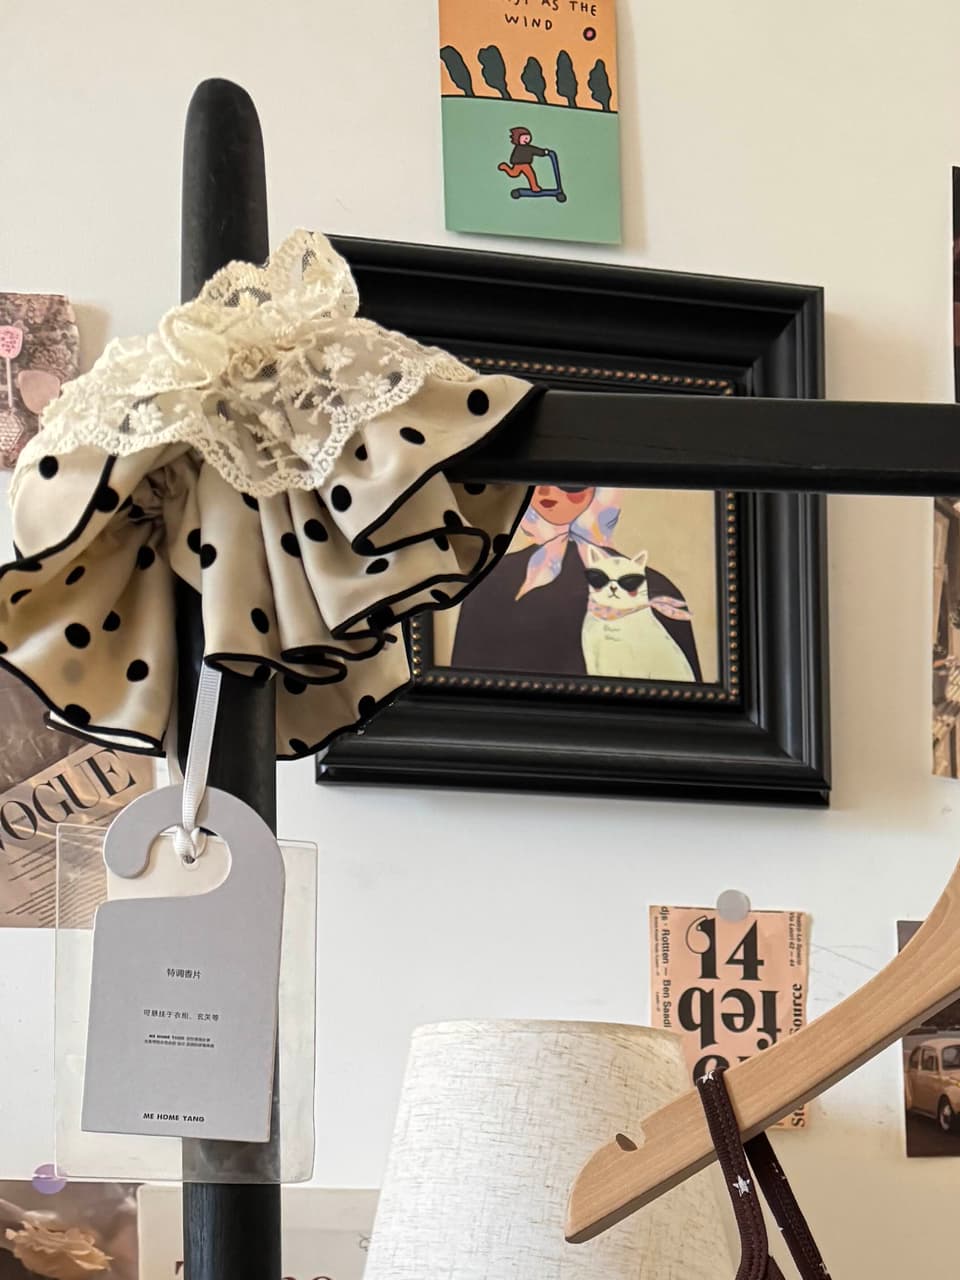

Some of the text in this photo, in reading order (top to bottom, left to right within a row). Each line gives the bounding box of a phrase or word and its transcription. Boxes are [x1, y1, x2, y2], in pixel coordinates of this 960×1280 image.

[569, 1, 597, 16] THE
[504, 13, 553, 31] WIND
[0, 749, 137, 851] OGUE
[685, 915, 765, 982] 14
[143, 1112, 205, 1122] ME HOME YANG
